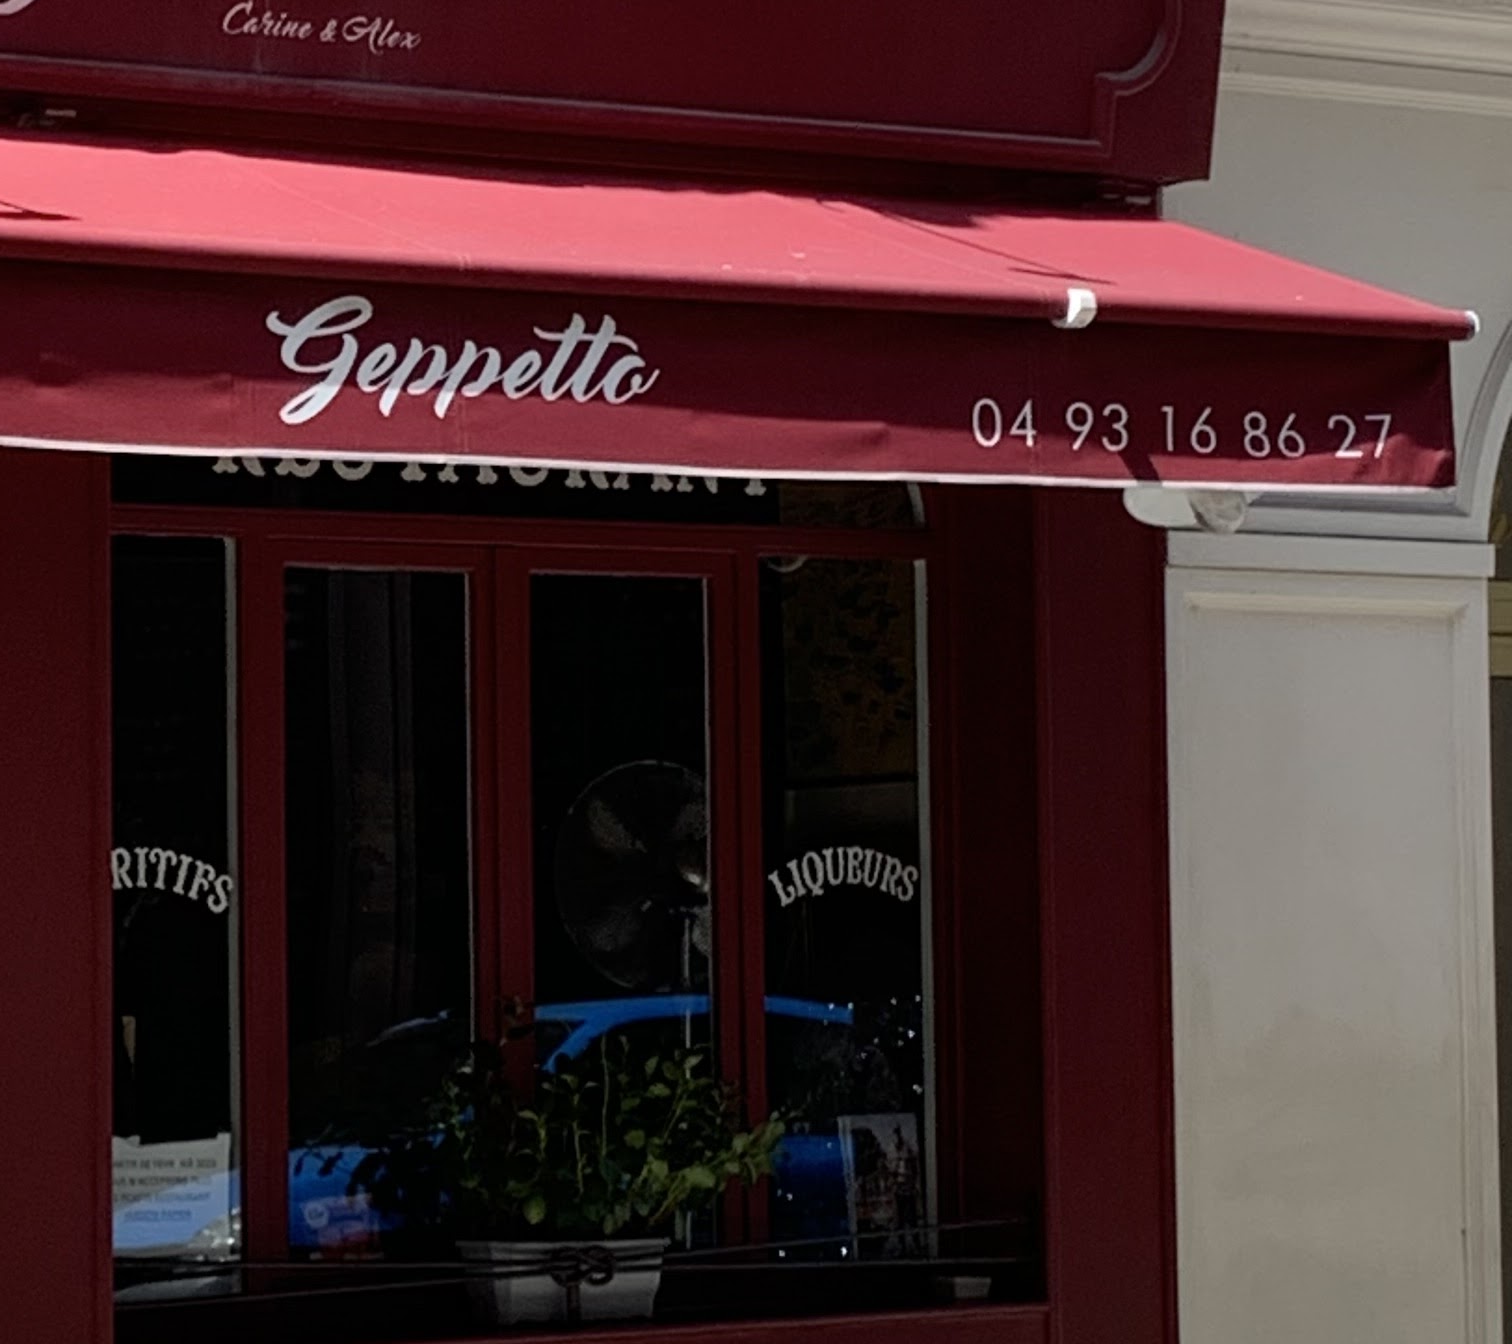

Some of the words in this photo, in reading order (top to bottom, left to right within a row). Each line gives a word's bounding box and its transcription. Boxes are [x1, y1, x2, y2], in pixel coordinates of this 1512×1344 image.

[221, 0, 314, 39] Carine
[319, 18, 338, 43] &
[342, 16, 421, 54] Alex
[266, 295, 660, 424] Geppetto
[971, 398, 1037, 448] 04
[1065, 401, 1129, 452] 93
[1160, 405, 1217, 454] 16
[1242, 411, 1306, 458] 86
[1327, 414, 1392, 459] 27
[110, 846, 234, 914] RITIFS
[767, 845, 919, 908] LIQUEURS
